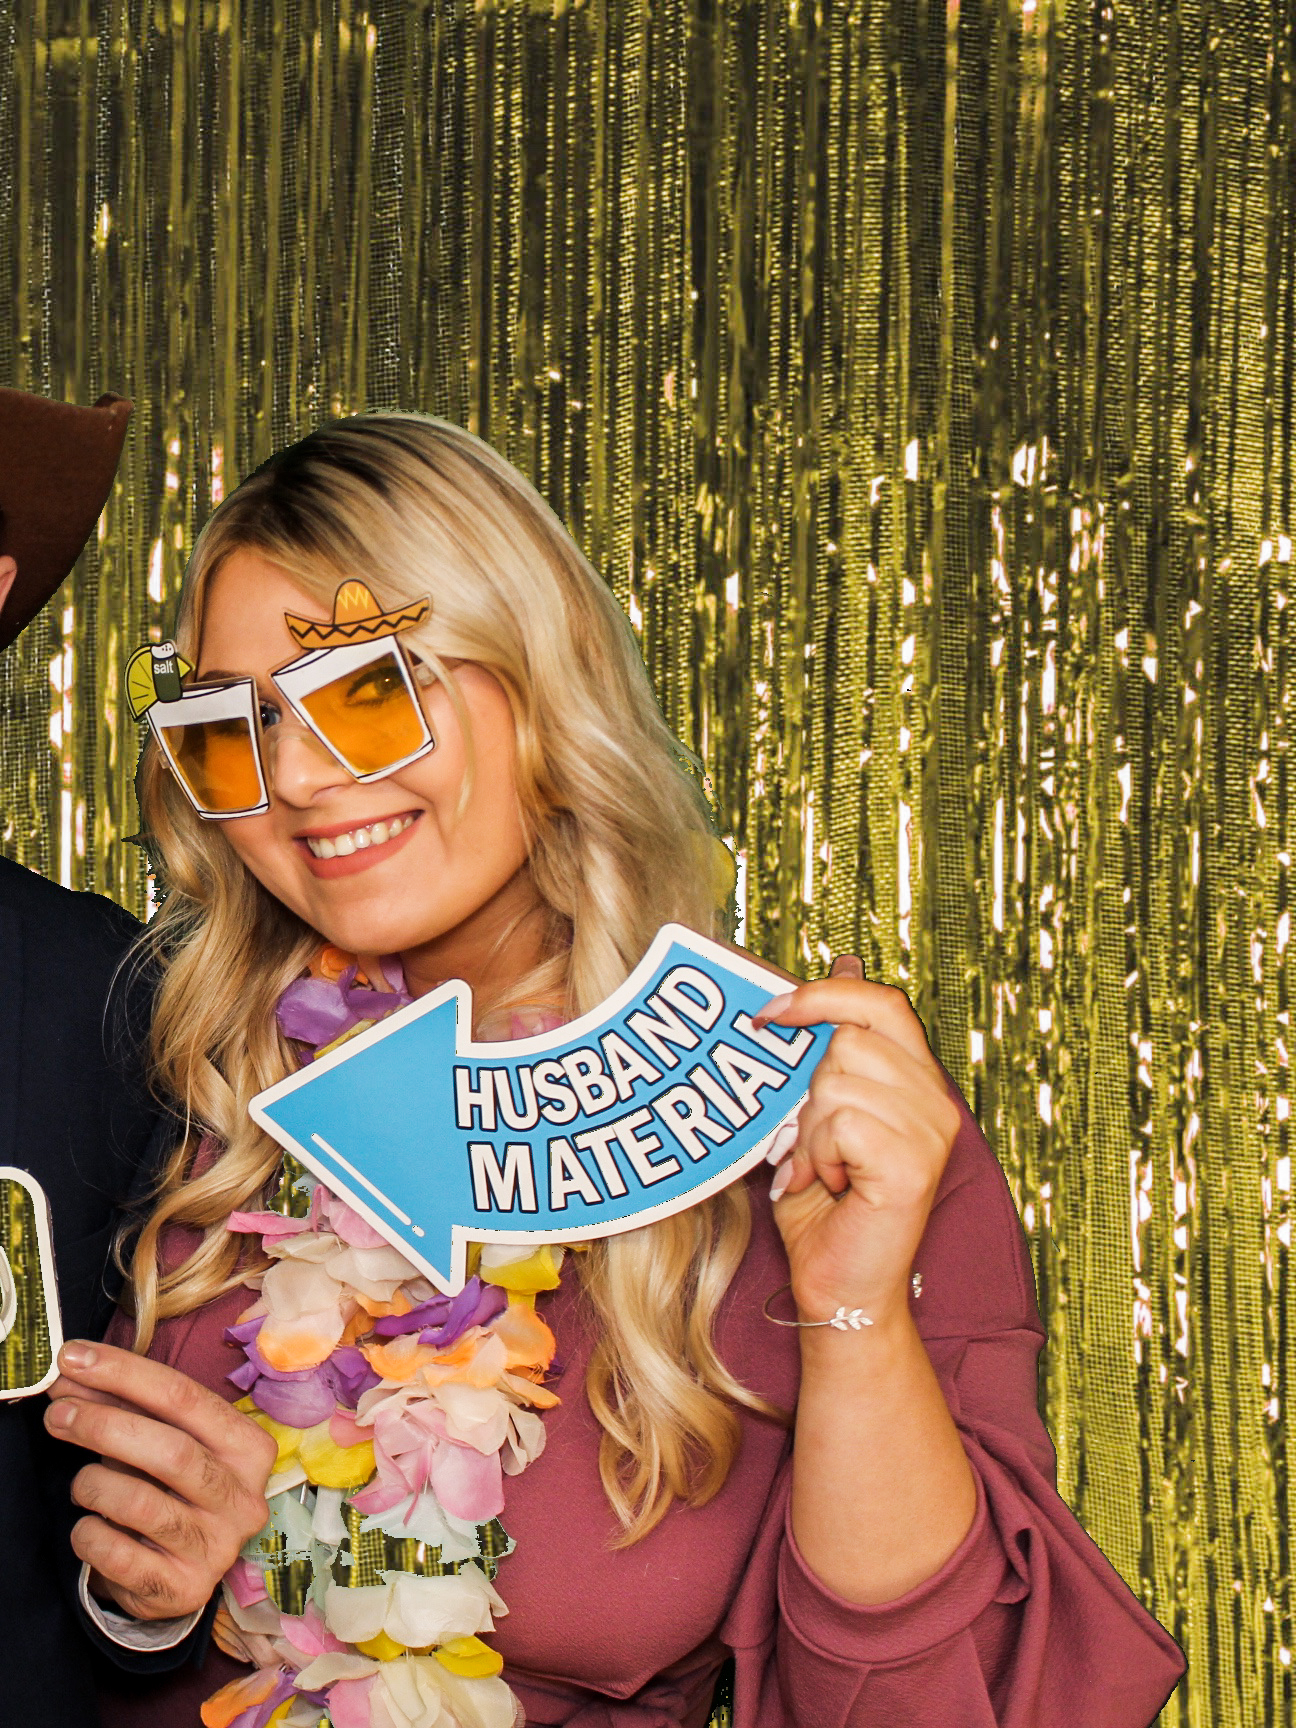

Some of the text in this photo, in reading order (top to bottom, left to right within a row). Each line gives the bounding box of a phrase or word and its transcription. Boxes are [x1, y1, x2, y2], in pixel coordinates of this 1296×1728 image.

[154, 660, 174, 674] salt
[454, 964, 725, 1132] HUSBAND
[468, 1010, 814, 1213] MATERIAL
